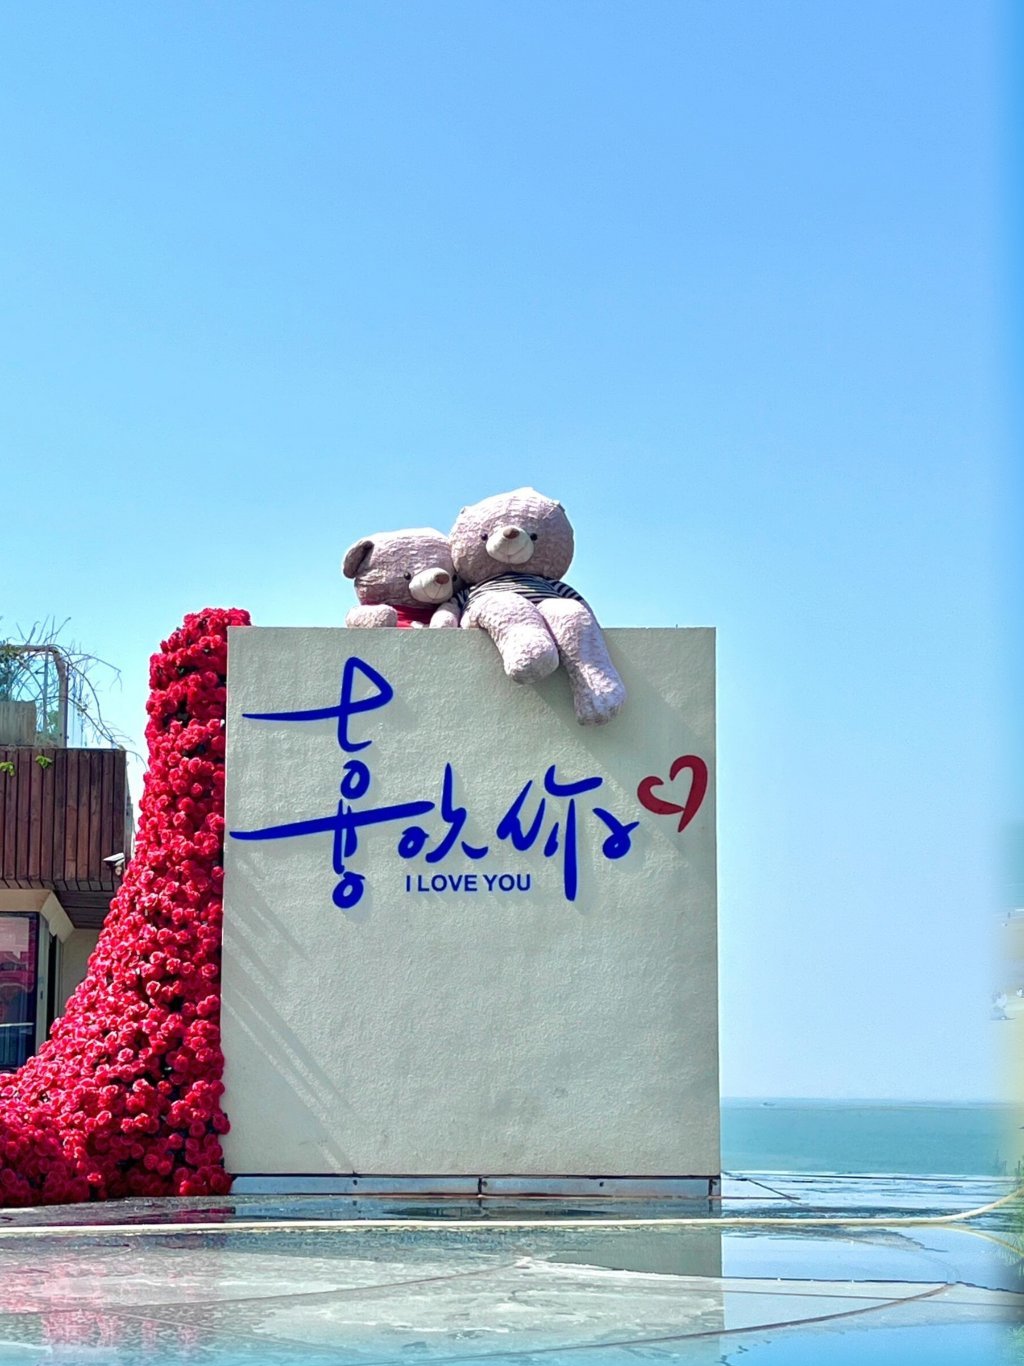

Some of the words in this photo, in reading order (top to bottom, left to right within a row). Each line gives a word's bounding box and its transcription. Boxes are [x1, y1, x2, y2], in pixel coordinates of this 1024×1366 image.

[229, 656, 640, 909] 喜欢你
[405, 874, 411, 892] I
[417, 874, 477, 892] LOVE
[484, 873, 531, 891] YOU
